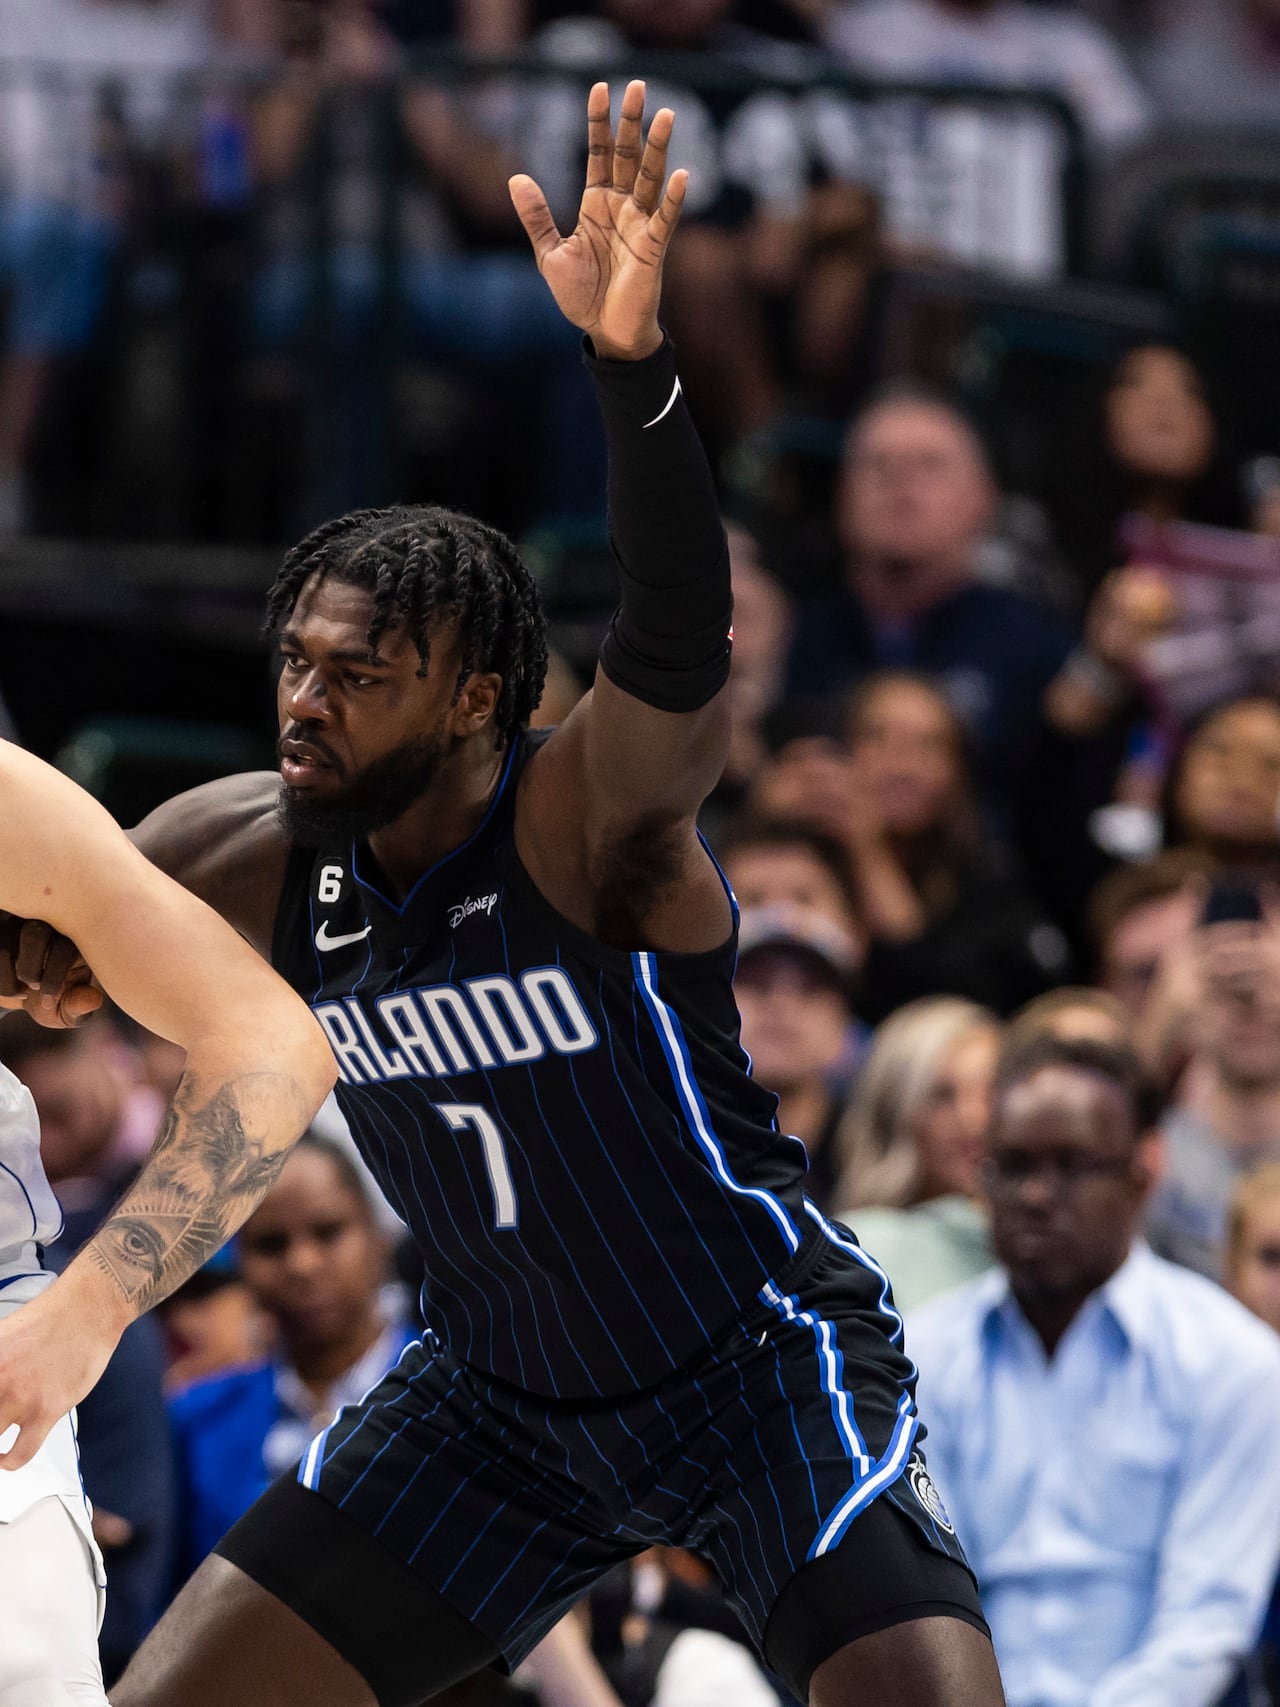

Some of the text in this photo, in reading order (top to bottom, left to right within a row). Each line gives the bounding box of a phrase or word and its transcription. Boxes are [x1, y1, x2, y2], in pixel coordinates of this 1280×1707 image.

[318, 865, 344, 903] 6
[310, 964, 601, 1086] RLANDO
[432, 1102, 520, 1232] 7
